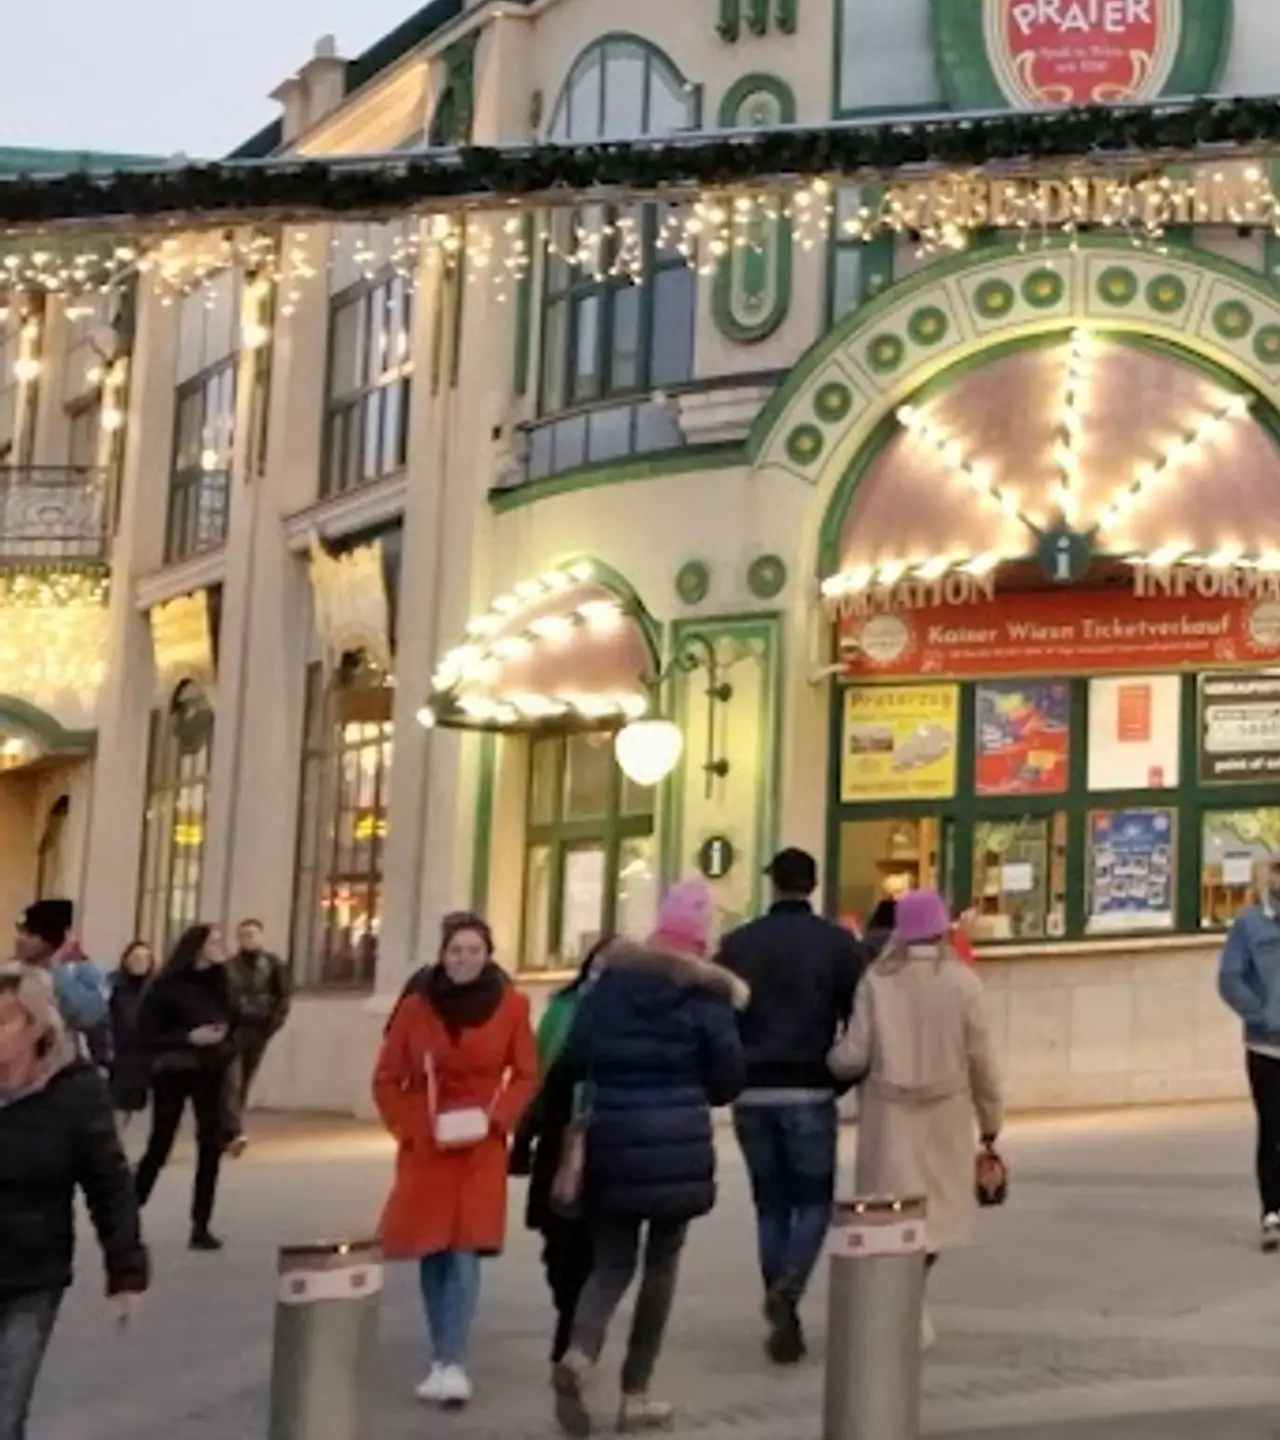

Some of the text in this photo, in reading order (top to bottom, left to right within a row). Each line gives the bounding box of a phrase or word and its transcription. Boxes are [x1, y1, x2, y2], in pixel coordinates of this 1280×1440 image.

[928, 612, 1231, 645] Kaiser Wiesn Ticketverkauf
